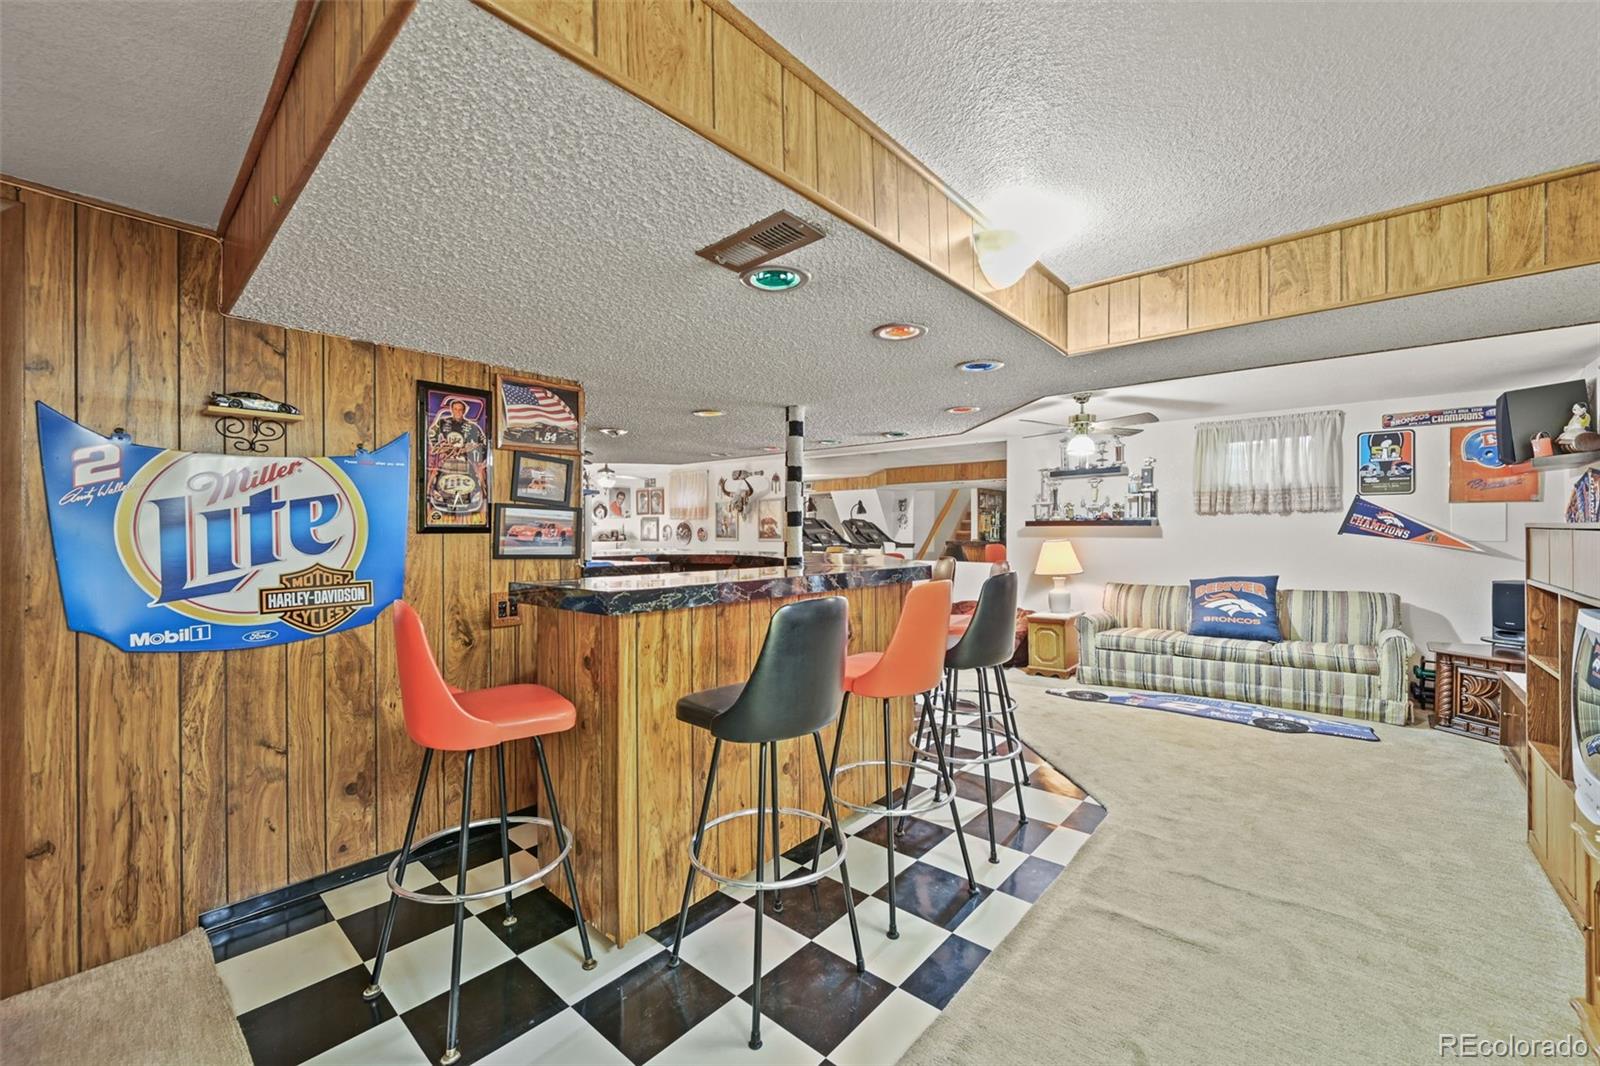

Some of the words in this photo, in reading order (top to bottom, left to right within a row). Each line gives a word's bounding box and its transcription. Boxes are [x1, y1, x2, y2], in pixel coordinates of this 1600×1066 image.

[1431, 411, 1484, 424] CHAMPIONS
[72, 443, 122, 488] 2
[186, 460, 302, 506] Miller
[1349, 515, 1410, 539] CHAMPIONS
[145, 484, 344, 607] Lite
[292, 569, 344, 588] MOTOR
[267, 586, 366, 609] HARLEY-DAVIDSON
[1195, 581, 1268, 599] DENVER
[292, 606, 344, 627] CYCLES
[1203, 616, 1261, 625] BRONCOS
[129, 628, 190, 647] Mobil
[248, 631, 272, 641] Ford
